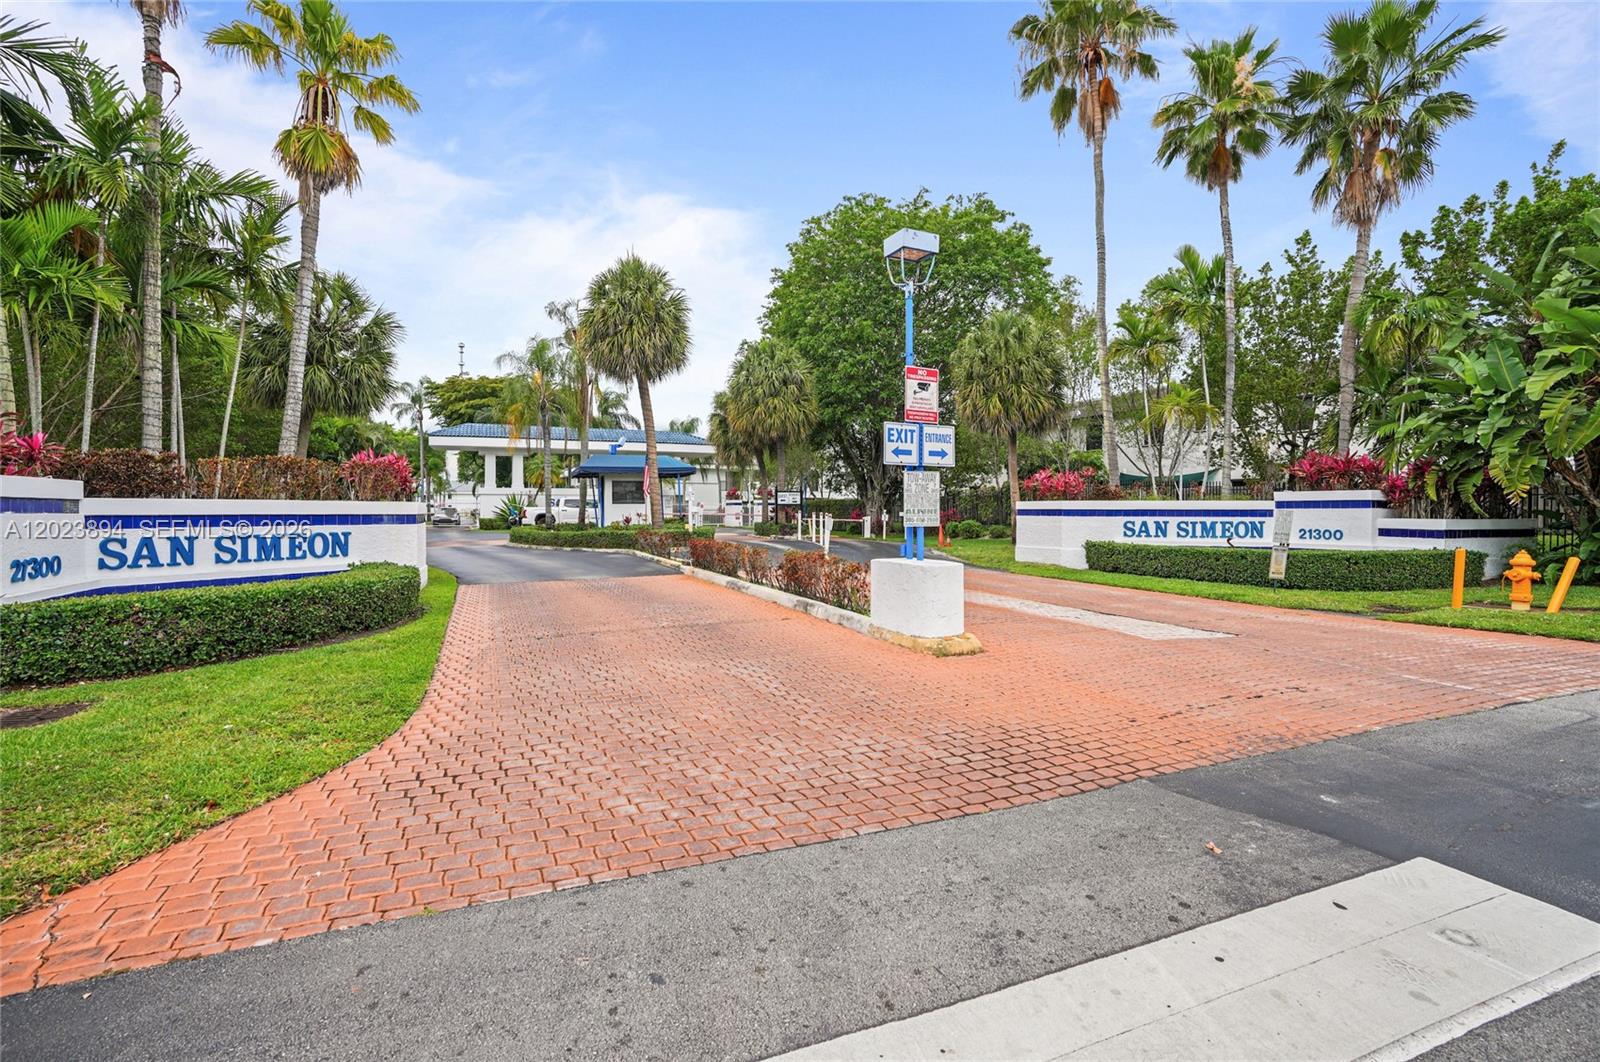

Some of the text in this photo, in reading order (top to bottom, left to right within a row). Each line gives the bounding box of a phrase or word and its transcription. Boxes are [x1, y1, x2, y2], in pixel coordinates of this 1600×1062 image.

[887, 427, 916, 444] EXIT
[924, 432, 953, 444] ENTRANCE
[1122, 520, 1170, 538] SAN
[1176, 520, 1266, 539] SIMEON
[1298, 528, 1344, 541] 21300
[97, 531, 352, 571] SAN SIMEON
[10, 555, 62, 583] 21300
